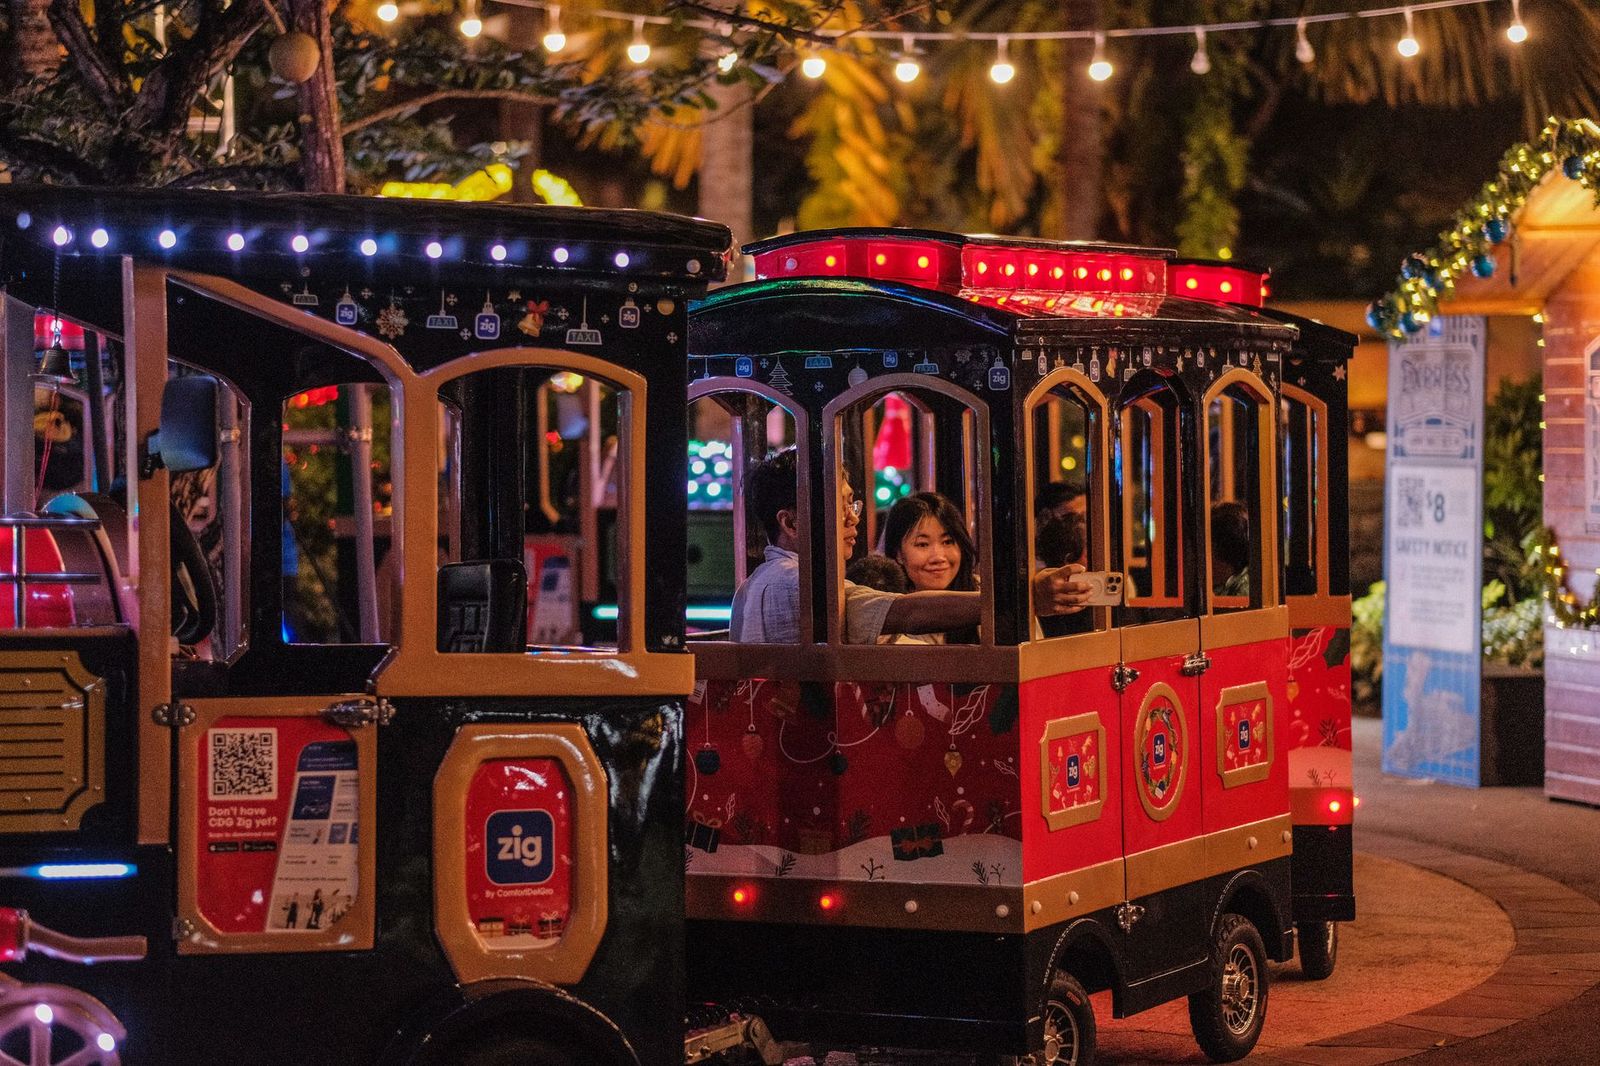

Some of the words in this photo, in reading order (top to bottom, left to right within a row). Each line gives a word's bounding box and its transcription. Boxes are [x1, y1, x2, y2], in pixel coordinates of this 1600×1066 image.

[340, 307, 354, 320] zig
[623, 310, 636, 323] zig
[431, 318, 453, 327] TAXI
[480, 318, 496, 333] zig
[571, 332, 596, 343] TAXI
[885, 354, 896, 364] zig
[738, 361, 750, 373] zig
[992, 371, 1006, 385] zig
[1240, 725, 1249, 742] zig
[1155, 739, 1164, 757] zig
[1068, 761, 1078, 779] zig
[208, 806, 238, 816] Don't
[240, 806, 267, 816] have
[208, 817, 234, 828] CDG
[236, 816, 253, 829] Zig
[255, 816, 278, 829] yet?
[497, 824, 543, 868] zig
